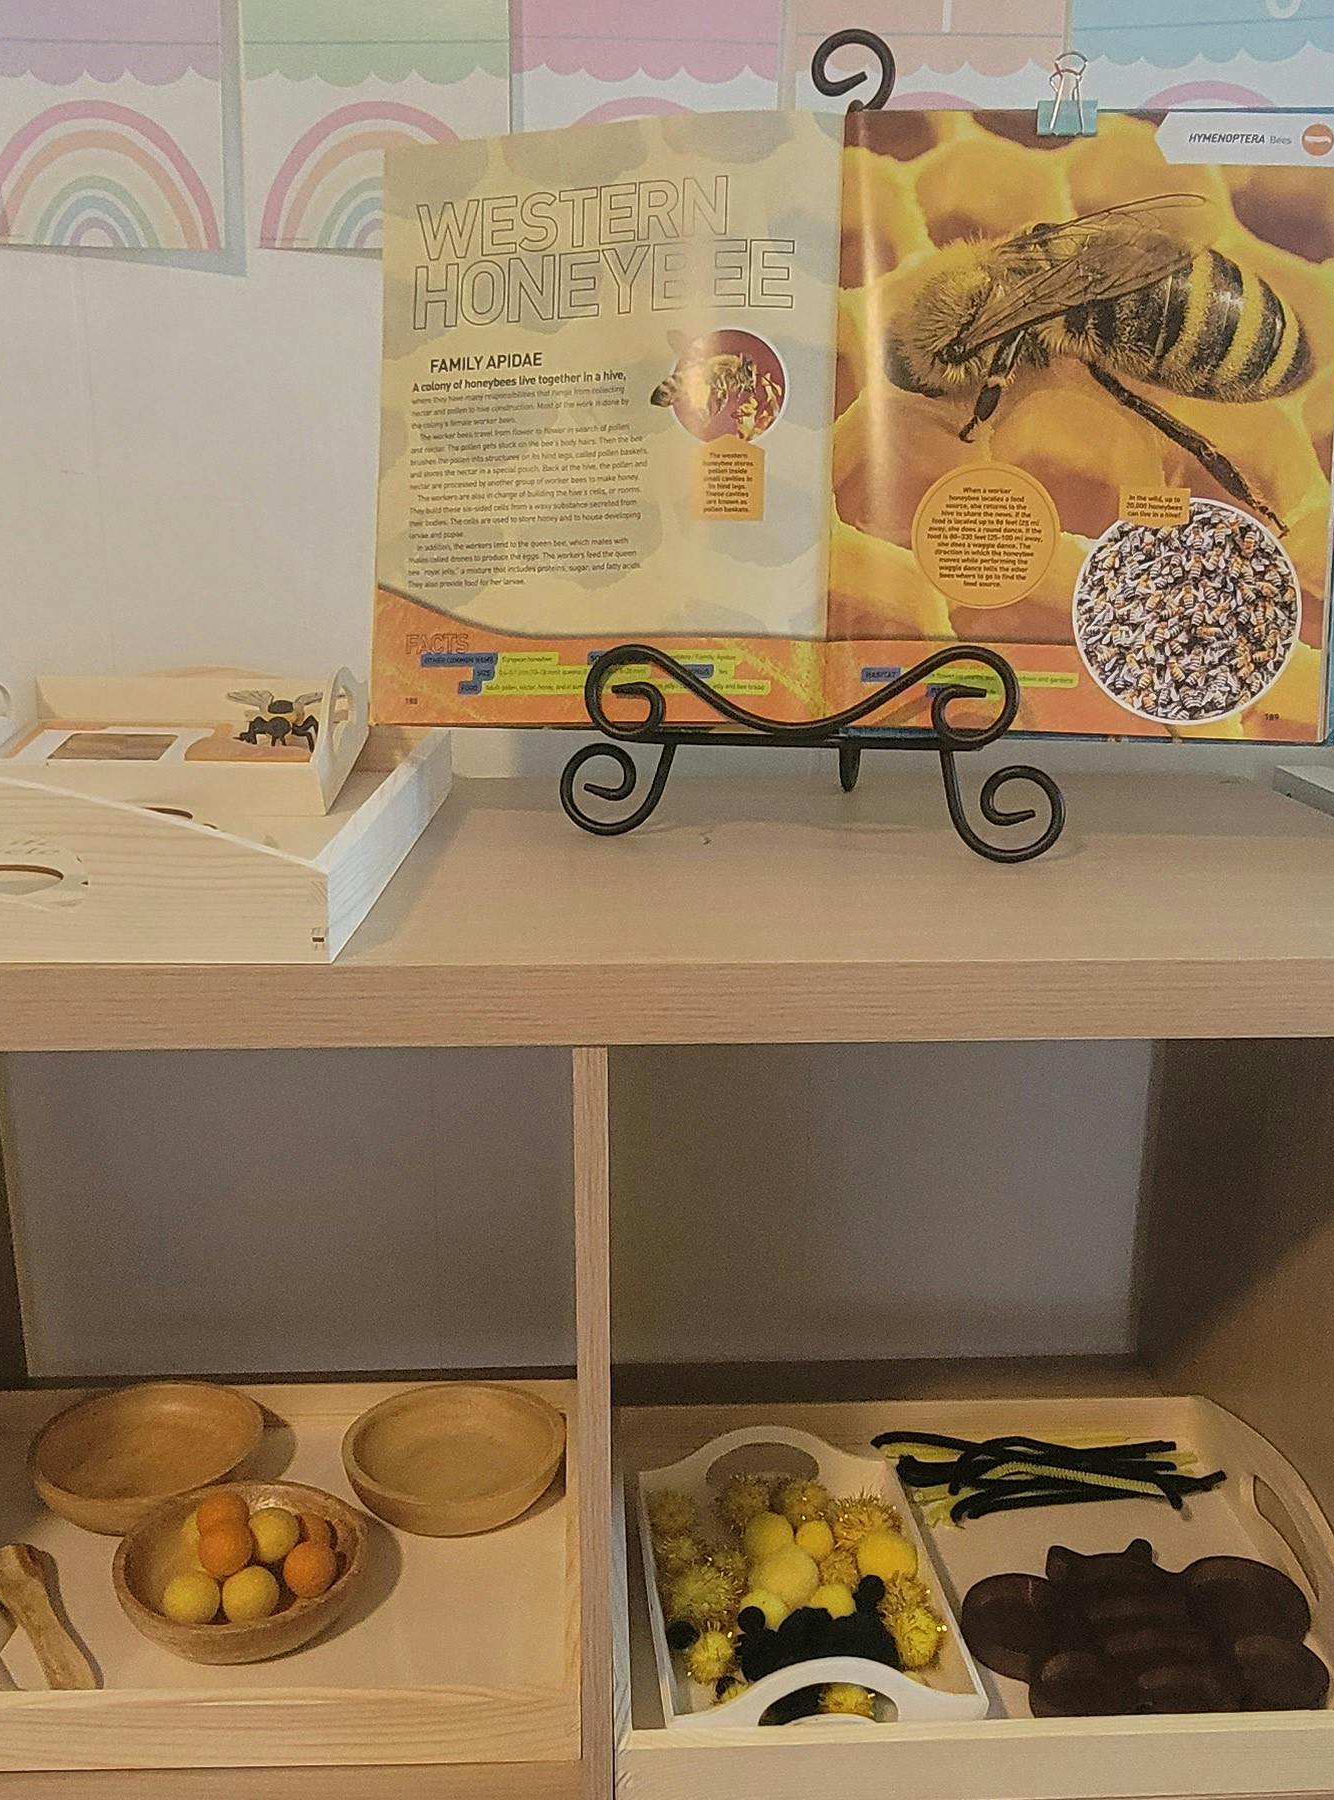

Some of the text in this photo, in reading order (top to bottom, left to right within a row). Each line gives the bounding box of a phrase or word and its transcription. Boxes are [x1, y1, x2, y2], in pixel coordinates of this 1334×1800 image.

[1188, 133, 1292, 145] HYMENOPTERA Bees
[417, 175, 729, 261] WESTERN
[412, 238, 797, 330] HONEYBEE
[430, 352, 543, 374] FAMILY APIDAE
[412, 383, 419, 392] A
[421, 381, 451, 392] colony
[453, 379, 463, 390] of
[465, 377, 516, 389] honeybees
[519, 375, 536, 385] live
[538, 373, 581, 386] together
[583, 371, 593, 382] in
[603, 369, 627, 381] hive,
[405, 633, 469, 654] FACTS
